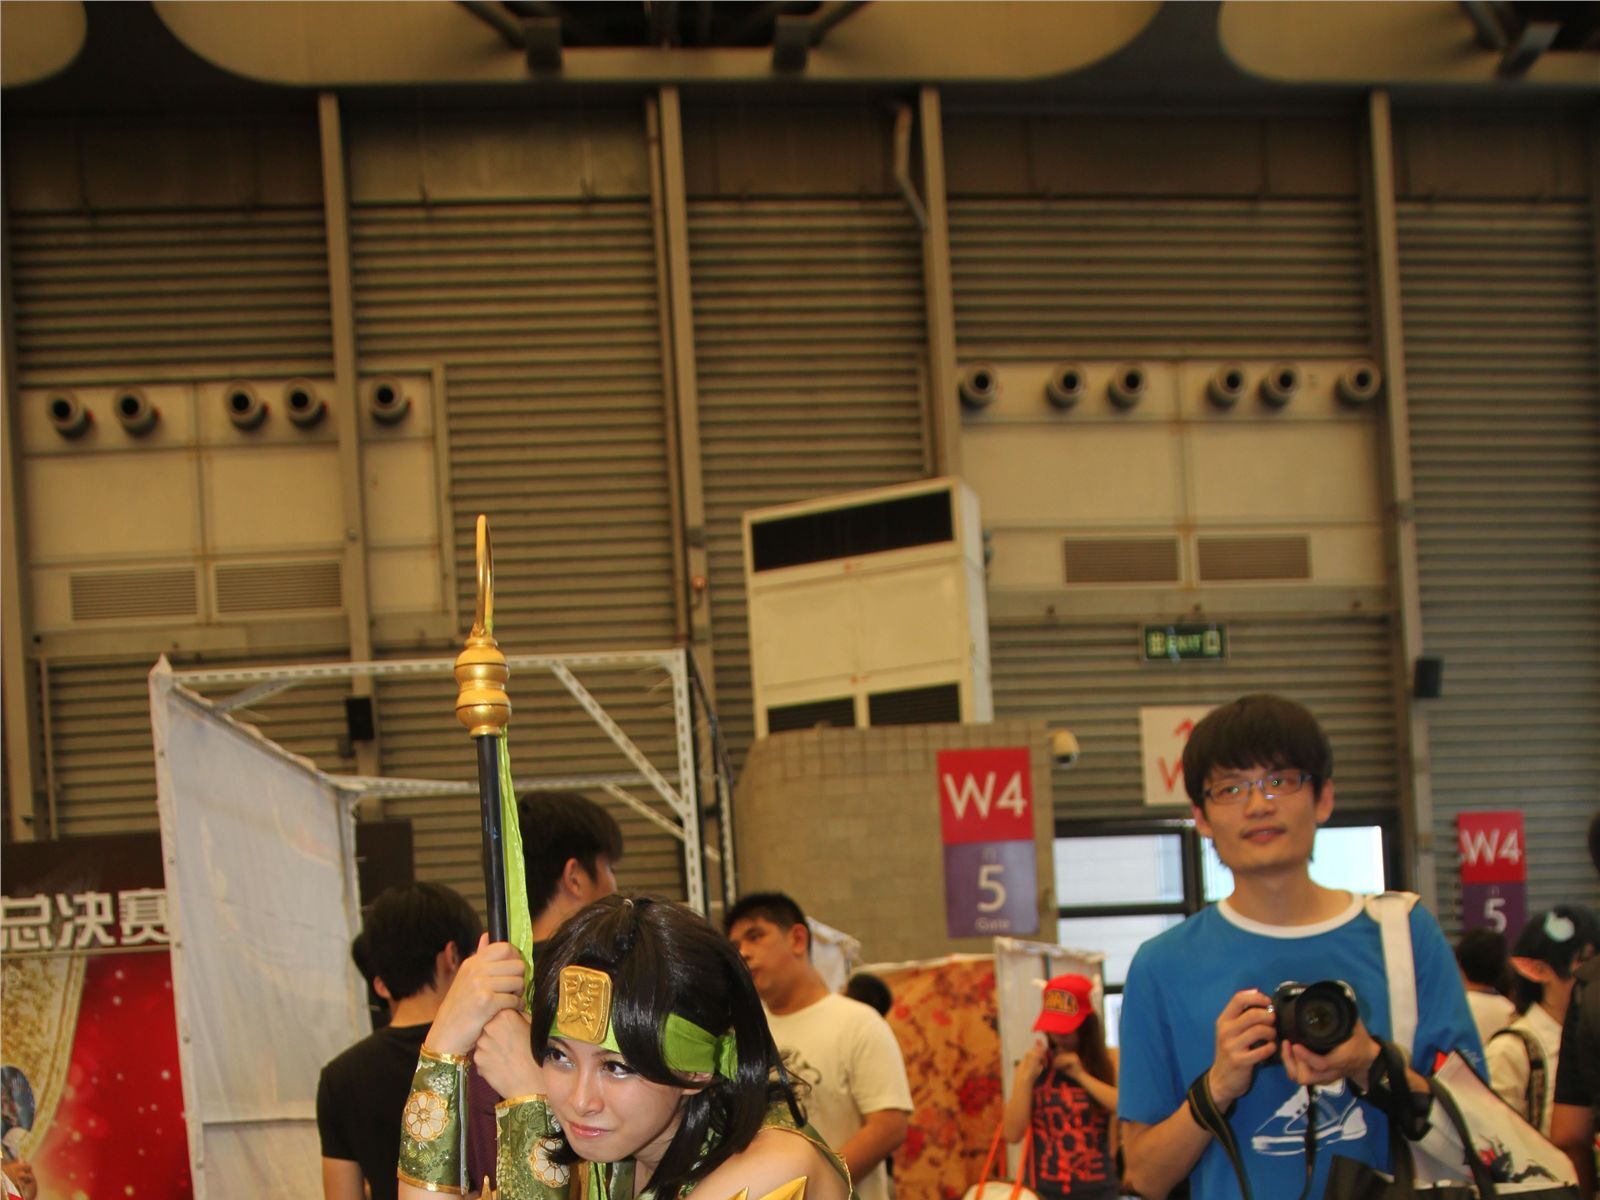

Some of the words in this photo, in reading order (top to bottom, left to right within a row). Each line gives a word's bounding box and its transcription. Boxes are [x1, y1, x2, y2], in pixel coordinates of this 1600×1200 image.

[944, 771, 1027, 819] W4
[1461, 829, 1522, 866] W4
[977, 864, 1007, 912] 5
[0, 888, 170, 949] 总决赛
[1485, 898, 1507, 934] 5
